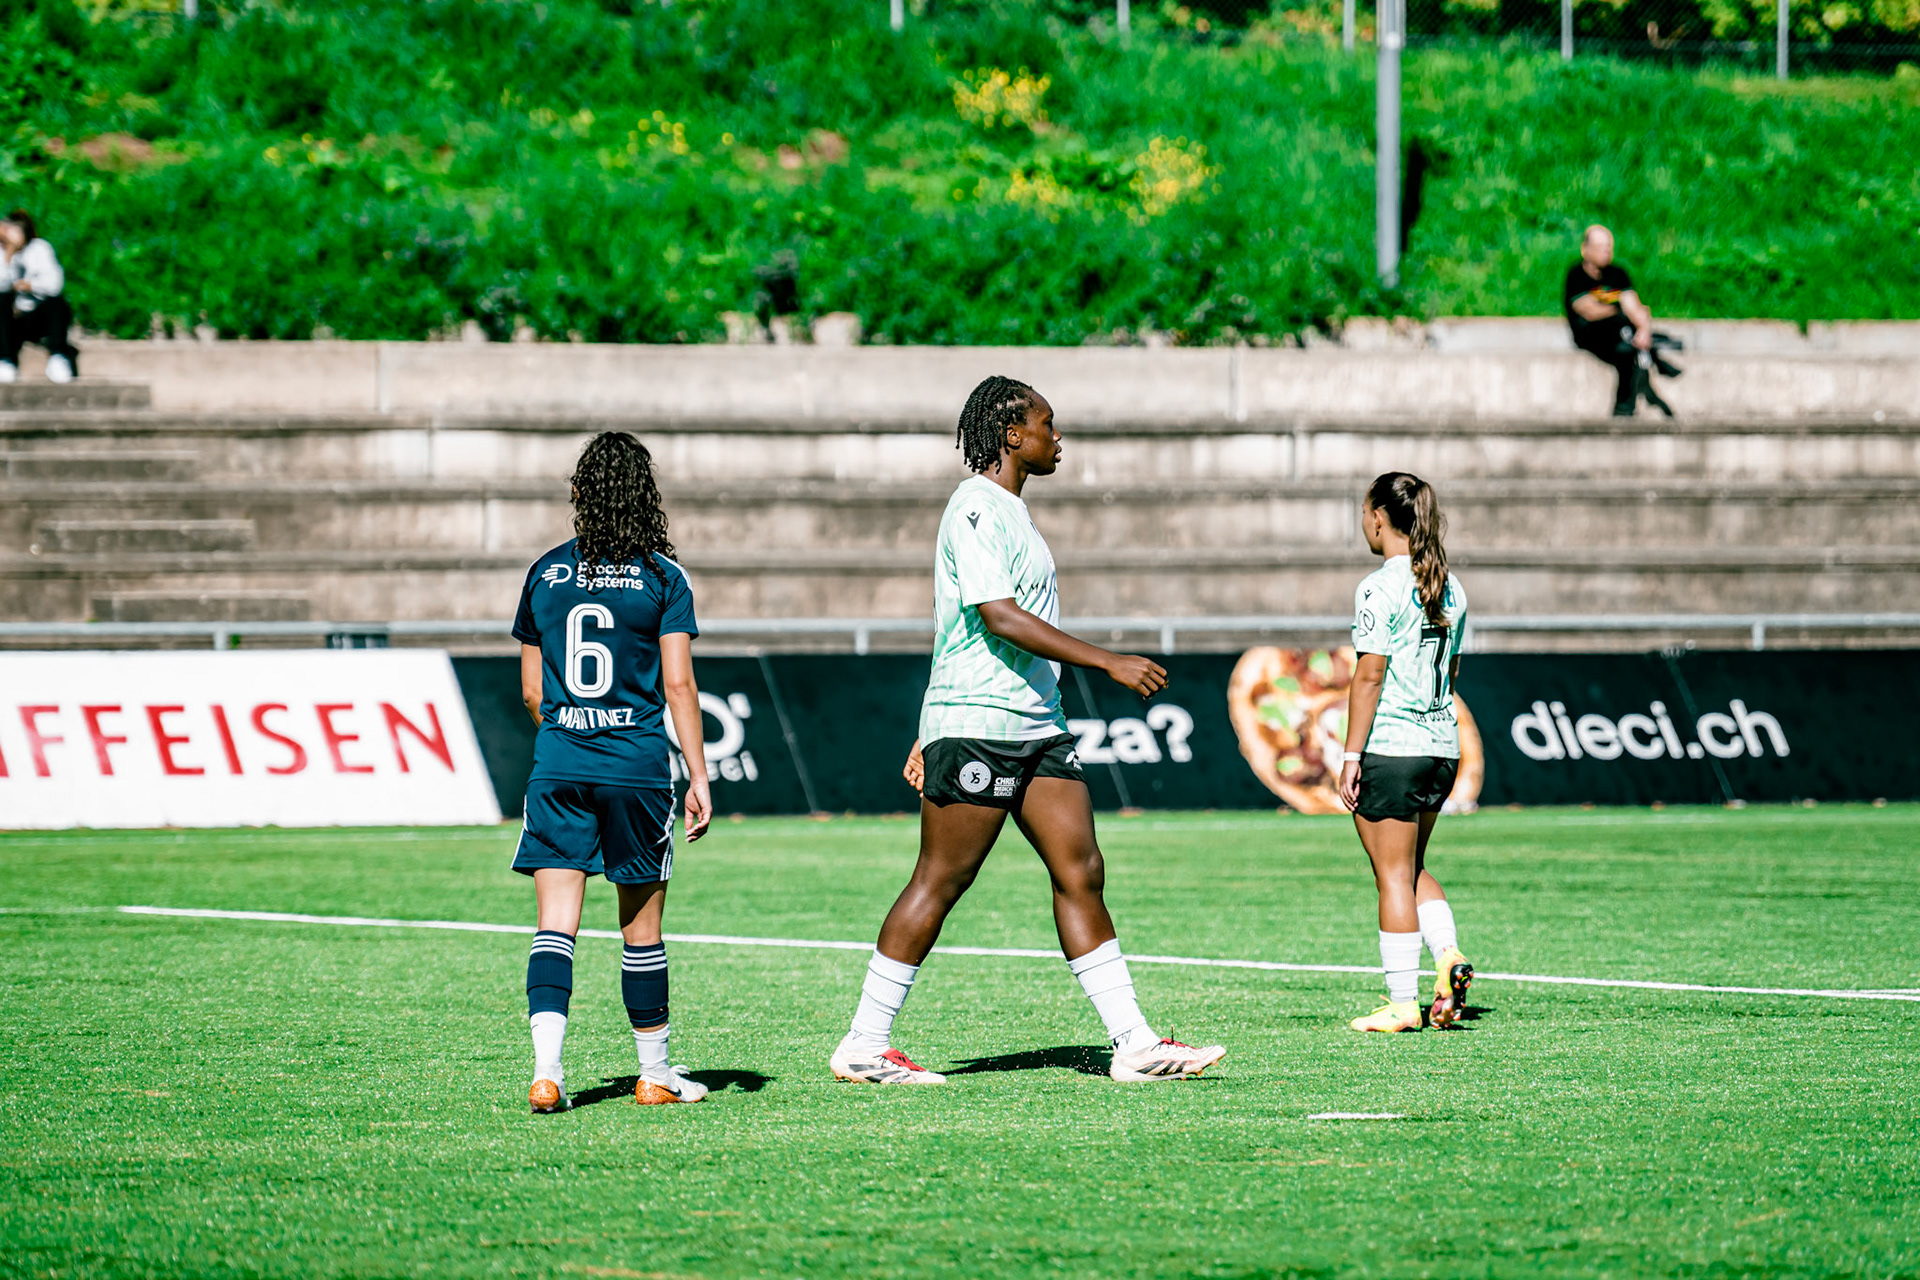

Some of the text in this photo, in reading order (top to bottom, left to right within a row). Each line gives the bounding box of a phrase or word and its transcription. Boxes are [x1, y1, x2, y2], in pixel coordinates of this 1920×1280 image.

[576, 574, 644, 592] Systems
[565, 603, 614, 698] 6
[557, 706, 636, 730] MARTINEZ
[1511, 699, 1790, 761] dieci.ch
[995, 777, 1016, 785] CHRIS
